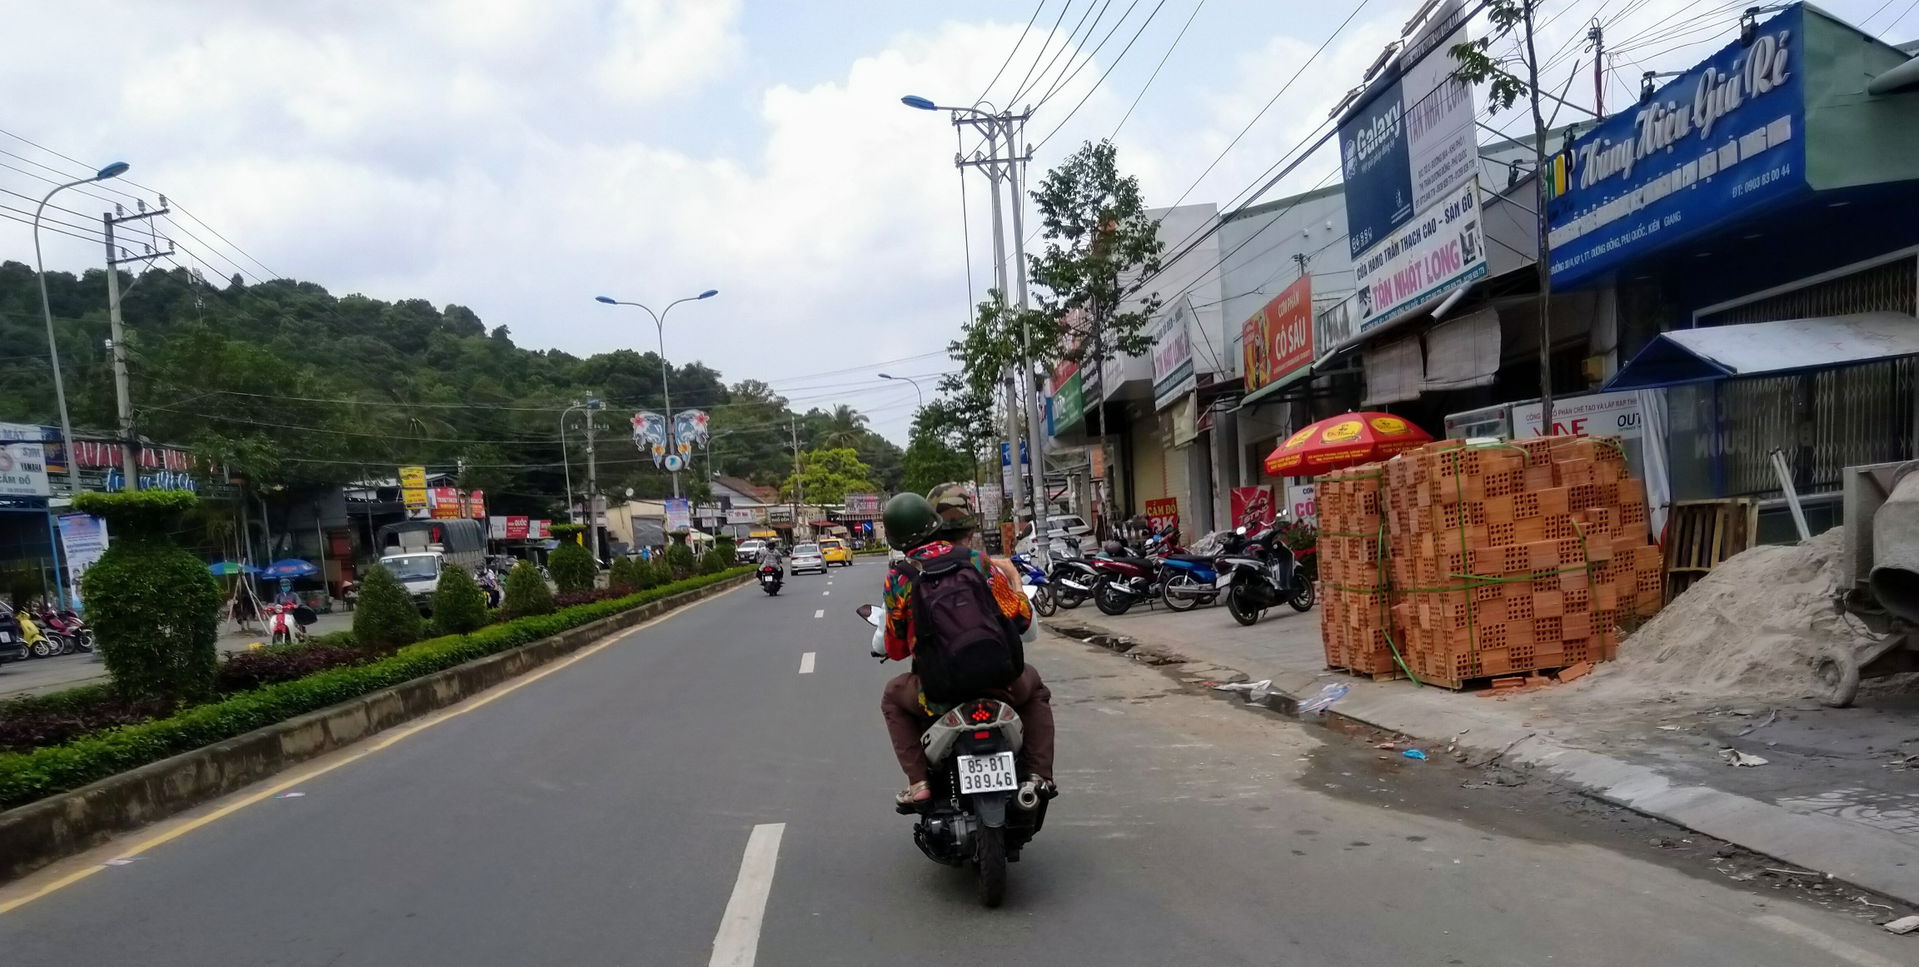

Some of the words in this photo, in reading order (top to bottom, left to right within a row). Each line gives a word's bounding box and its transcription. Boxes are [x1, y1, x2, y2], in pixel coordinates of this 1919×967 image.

[1579, 137, 1637, 190] Hùng
[1634, 101, 1694, 160] Hiện
[1692, 60, 1745, 140] Giá
[1744, 30, 1792, 99] Rẻ
[1357, 100, 1401, 160] Galaxy
[1761, 172, 1770, 186] 83
[1771, 167, 1780, 182] 00
[1781, 162, 1791, 176] 44
[1400, 227, 1422, 253] THẠCH
[1422, 217, 1437, 239] CAO
[1444, 200, 1461, 225] SÀN
[1461, 186, 1473, 213] GỖ
[1663, 210, 1682, 227] GIANG
[1372, 277, 1393, 312] TÂN
[1393, 254, 1423, 301] NHẤT
[1424, 239, 1461, 284] LONG
[1275, 324, 1287, 361] CÔ
[1288, 315, 1306, 354] SÁU
[21, 462, 42, 473] YAMAHA
[1151, 515, 1174, 533] 3K
[968, 758, 1004, 773] 85-B1
[964, 771, 1012, 790] 389.46
